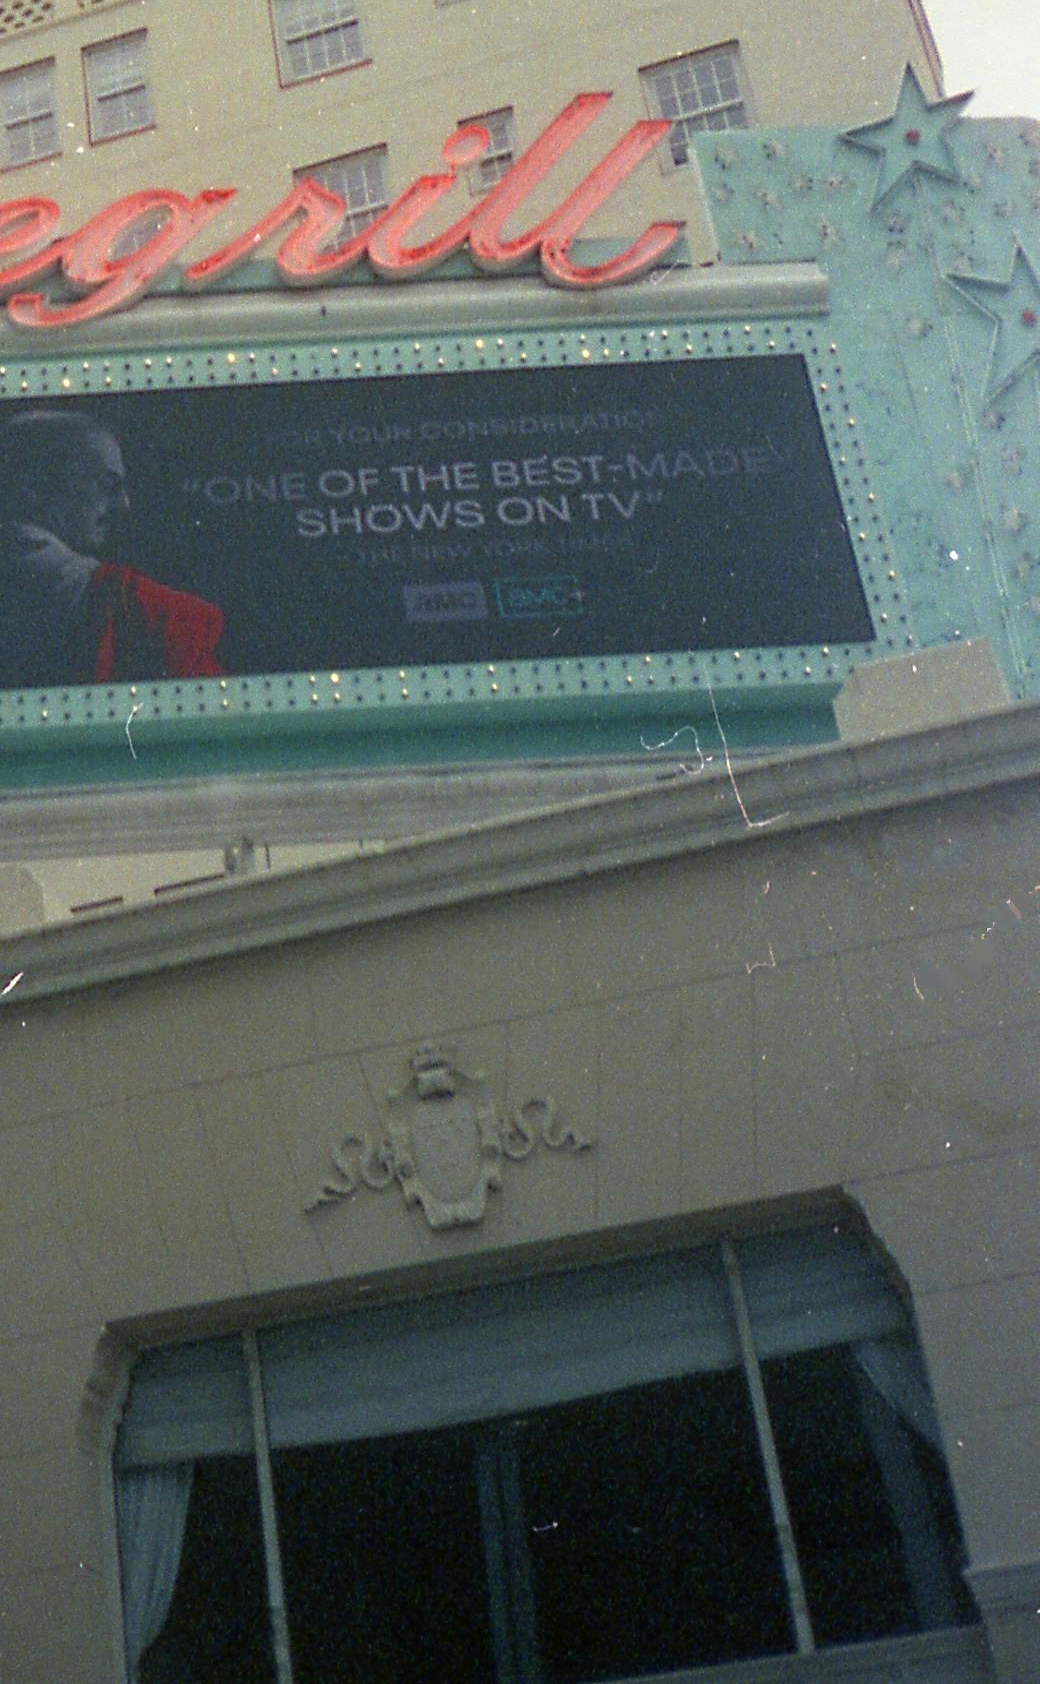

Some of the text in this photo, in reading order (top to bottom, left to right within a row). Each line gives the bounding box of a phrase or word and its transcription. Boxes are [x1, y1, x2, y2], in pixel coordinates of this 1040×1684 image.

[318, 469, 380, 498] OF
[390, 462, 481, 494] THE
[491, 447, 773, 489] BEST-MADE
[297, 499, 485, 537] SHOWS
[497, 496, 571, 525] ON
